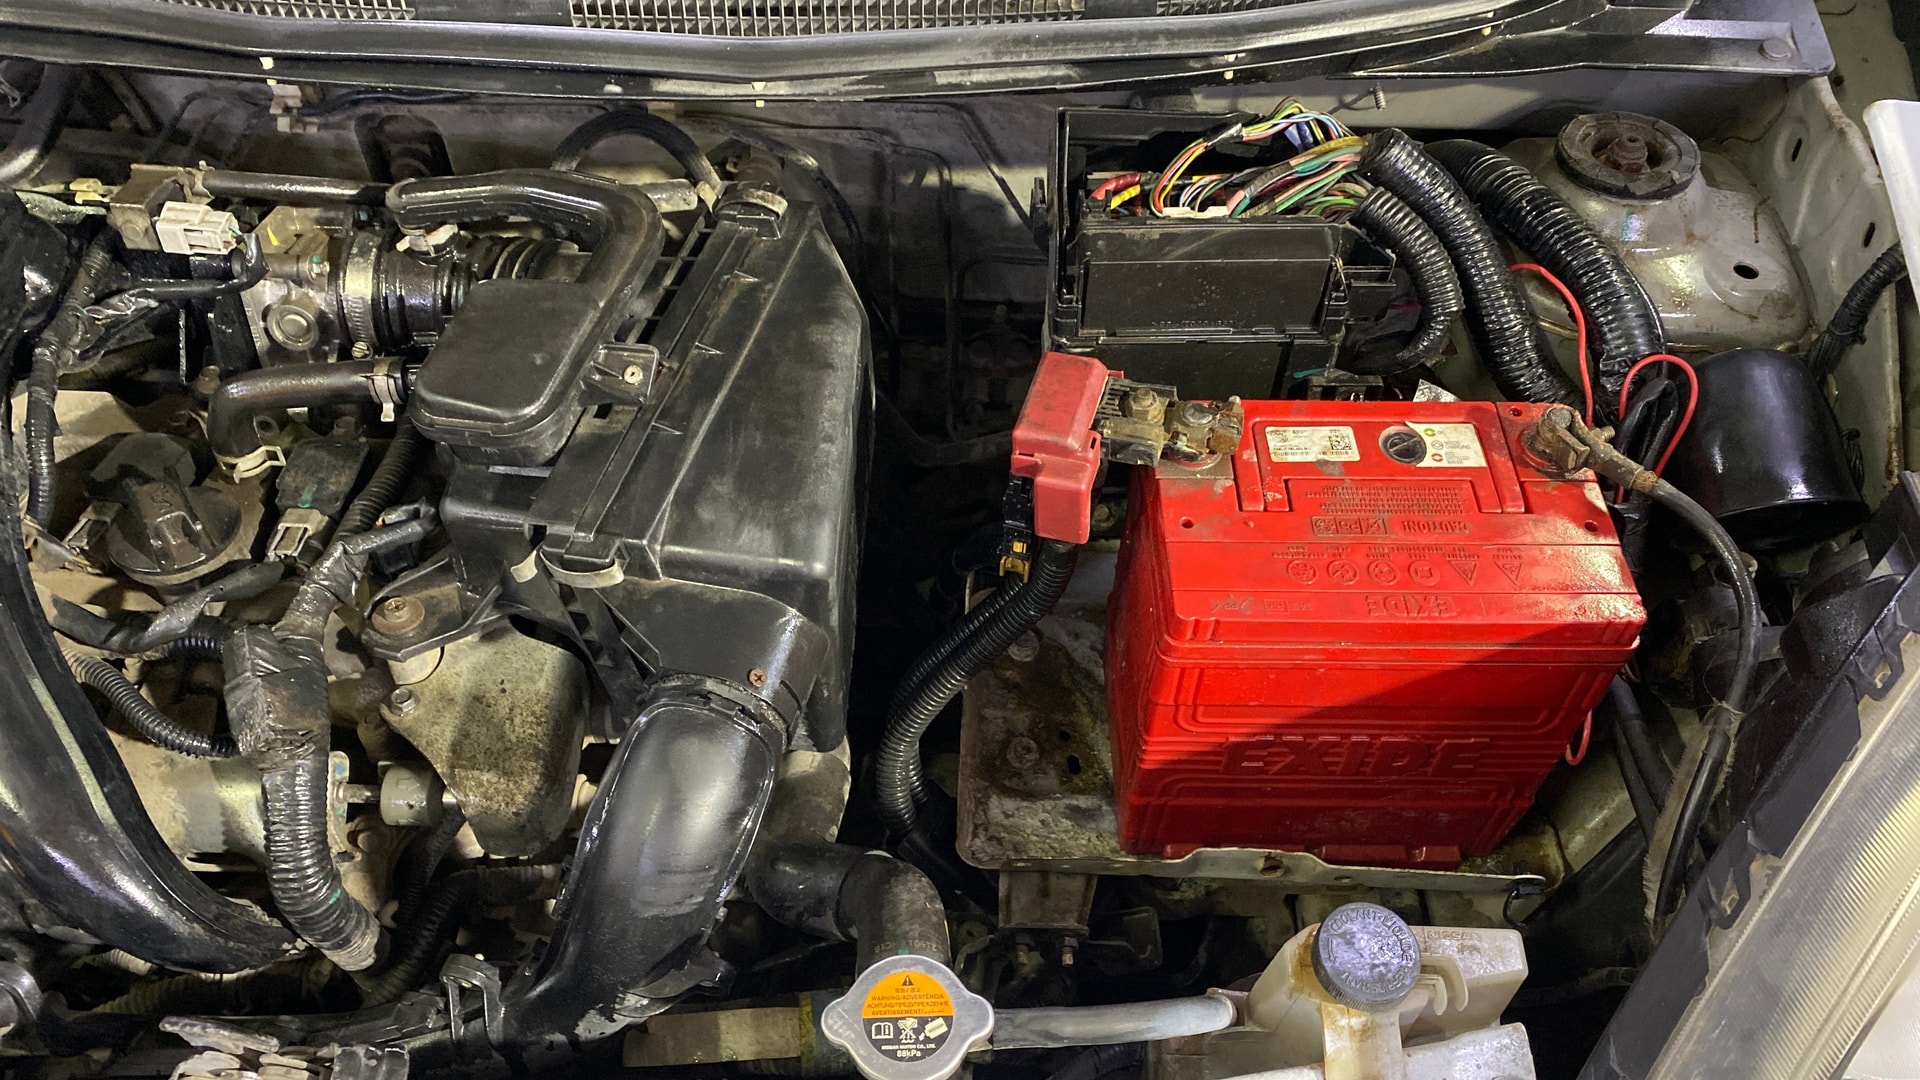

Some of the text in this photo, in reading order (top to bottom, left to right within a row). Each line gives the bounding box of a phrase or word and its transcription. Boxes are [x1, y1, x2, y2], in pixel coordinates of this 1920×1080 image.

[1365, 595, 1457, 617] EXIDE
[1219, 735, 1491, 775] EXIDE
[1330, 909, 1378, 932] COOLANT
[1427, 930, 1481, 940] NISSAN
